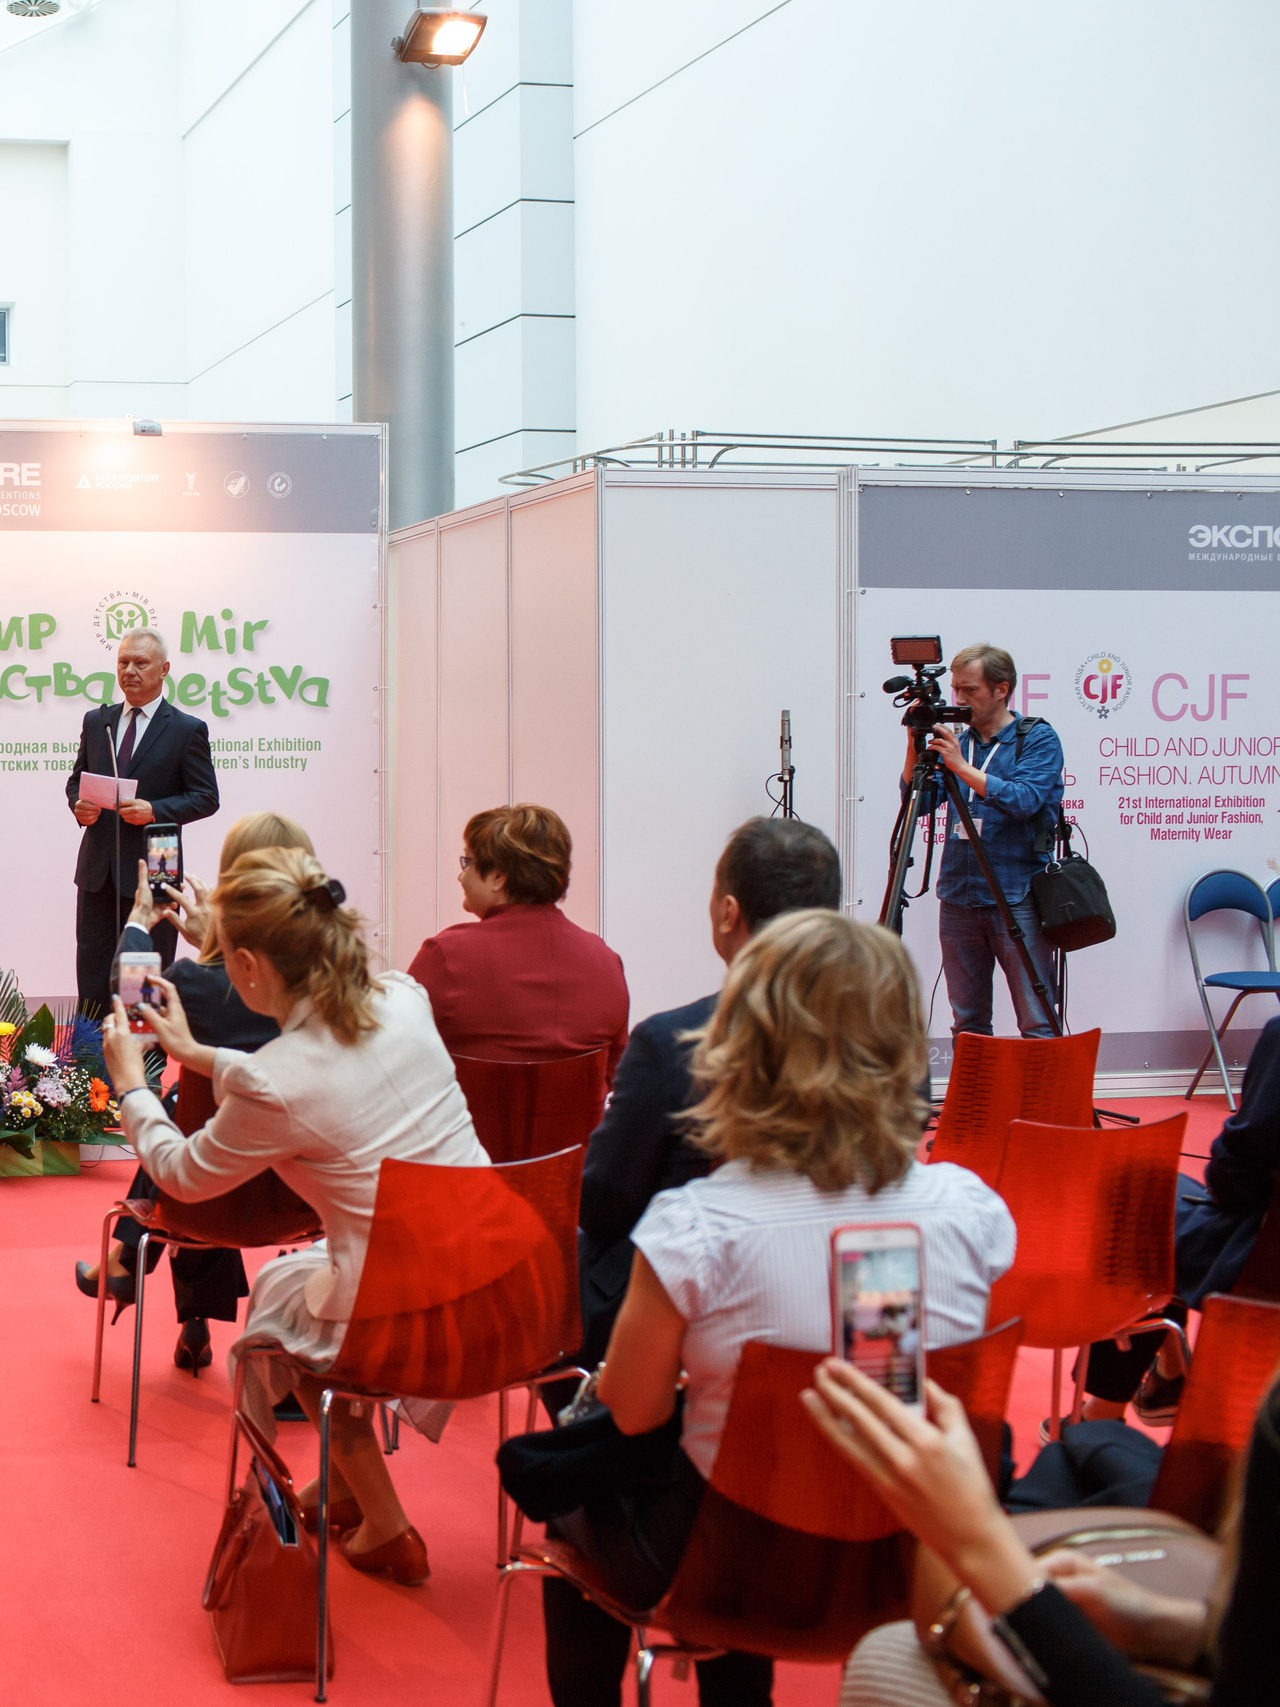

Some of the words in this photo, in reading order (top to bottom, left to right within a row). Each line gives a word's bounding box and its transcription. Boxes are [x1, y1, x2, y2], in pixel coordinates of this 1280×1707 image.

[1188, 524, 1280, 548] ЭКСП
[1188, 553, 1274, 562] МЕЖДУНАРОДНЫЕ
[148, 608, 158, 627] DET
[180, 608, 269, 655] Mir
[1087, 652, 1106, 663] CHILD
[1107, 653, 1121, 663] AND
[1151, 672, 1250, 722] CJF
[51, 742, 79, 754] выс
[209, 738, 253, 752] ational
[258, 738, 322, 752] Exhibition
[1099, 737, 1160, 757] CHILD
[1164, 737, 1208, 756] AND
[43, 760, 74, 772] това
[210, 756, 250, 769] dren’s
[254, 755, 308, 771] Industry
[1099, 766, 1192, 785] FASHION.
[1061, 799, 1084, 809] авка
[1118, 796, 1142, 809] 21st
[1145, 796, 1212, 808] International
[1214, 795, 1266, 808] Exhibition
[1120, 812, 1134, 825] for
[1137, 812, 1162, 825] Child
[1165, 812, 1184, 825] and
[1187, 811, 1219, 824] Junior
[1221, 811, 1264, 825] Fashion,
[1150, 828, 1199, 842] Maternity
[1204, 827, 1233, 840] Wear
